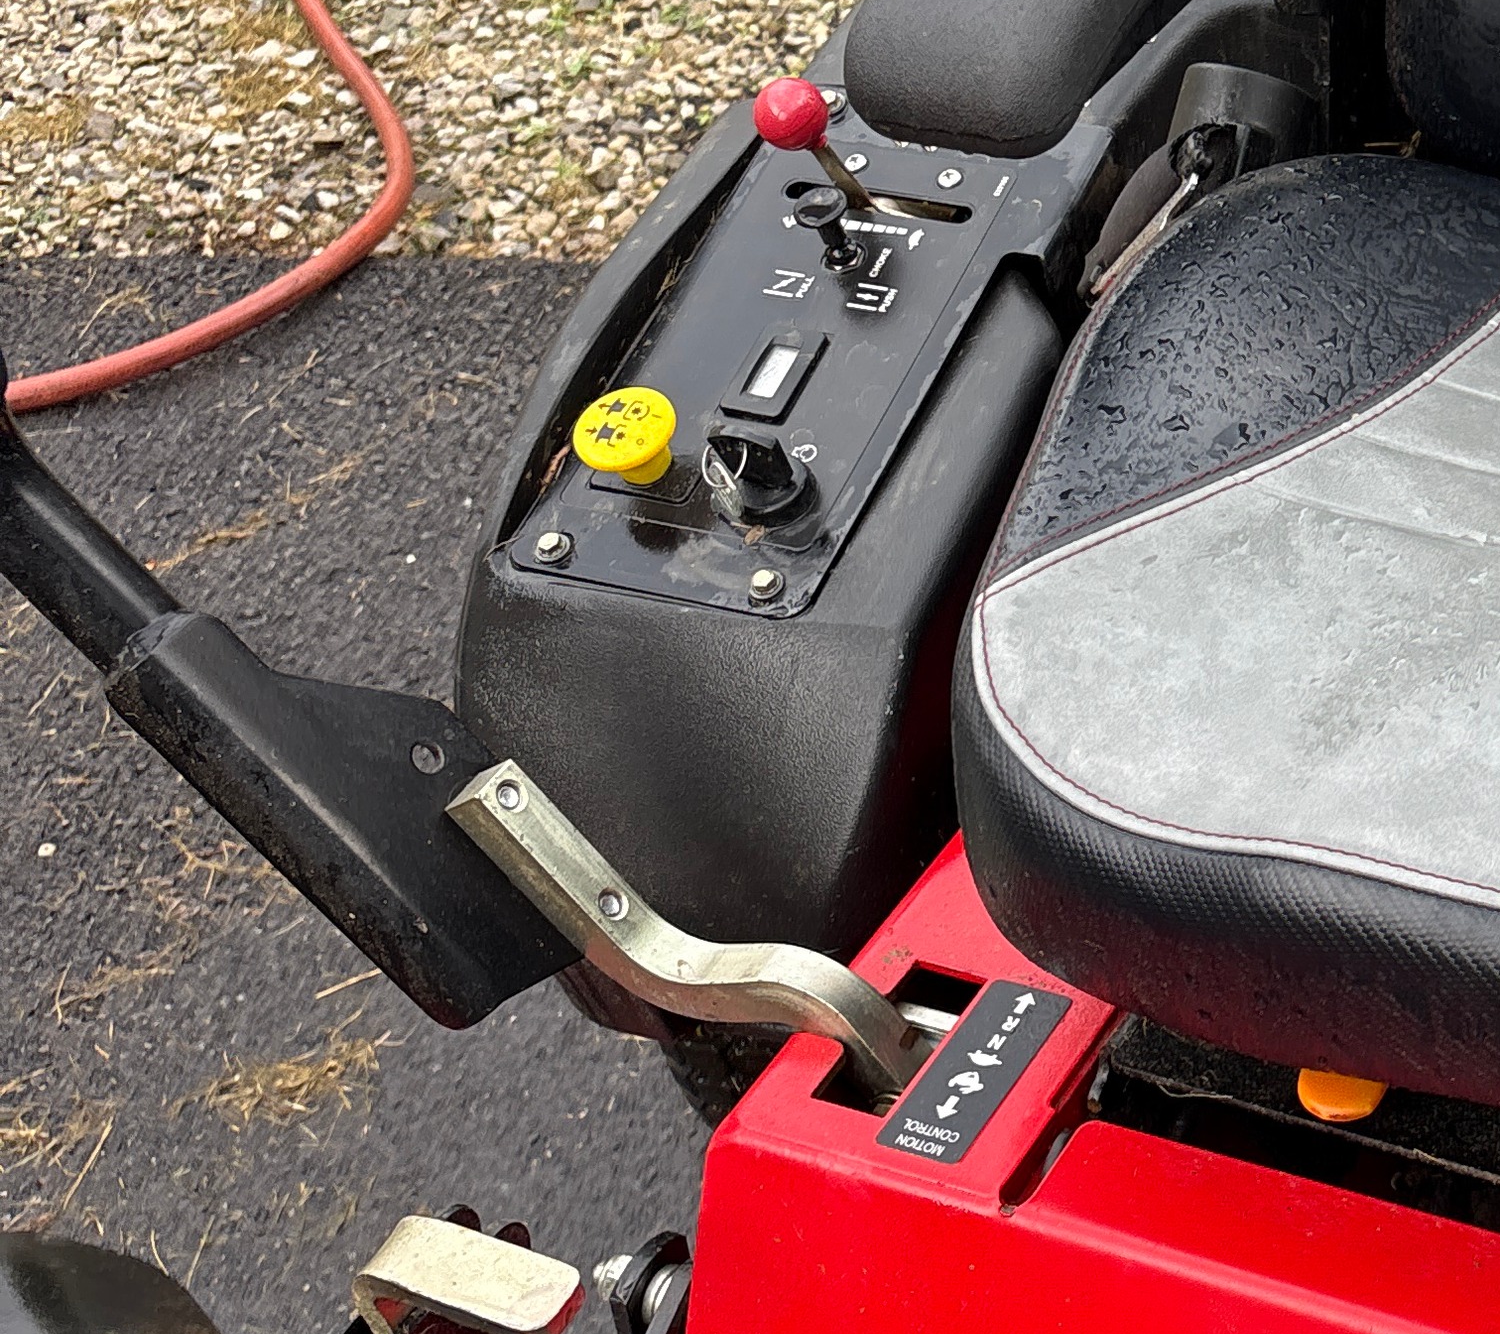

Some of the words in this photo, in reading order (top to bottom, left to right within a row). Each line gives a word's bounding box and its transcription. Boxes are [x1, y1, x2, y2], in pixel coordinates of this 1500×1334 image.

[869, 247, 893, 278] CHOKE
[795, 276, 816, 298] PULL
[878, 288, 899, 312] PUSH
[1001, 1016, 1020, 1032] R
[987, 1034, 1007, 1050] N
[903, 1118, 960, 1143] CONTROL
[894, 1133, 945, 1157] MOTION
